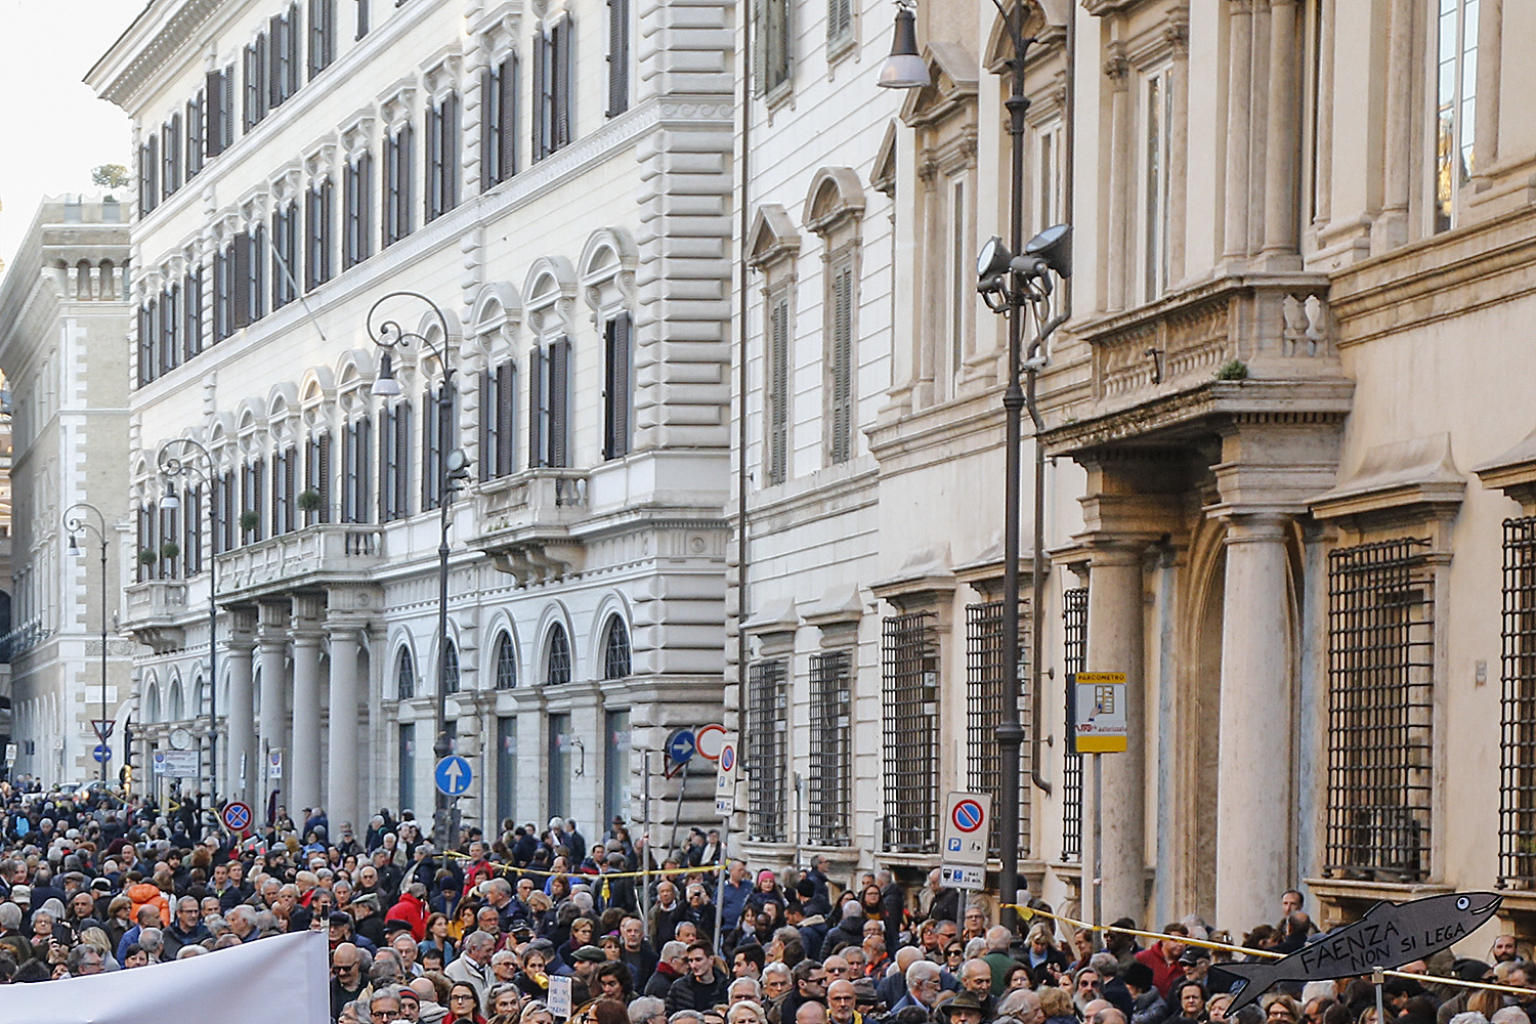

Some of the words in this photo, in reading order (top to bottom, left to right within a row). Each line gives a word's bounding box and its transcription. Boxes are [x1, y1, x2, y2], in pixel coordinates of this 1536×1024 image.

[950, 838, 961, 850] P
[1300, 921, 1400, 975] FAENZA
[1350, 945, 1391, 972] NON
[1401, 936, 1417, 953] SI
[1425, 921, 1466, 948] LEGA
